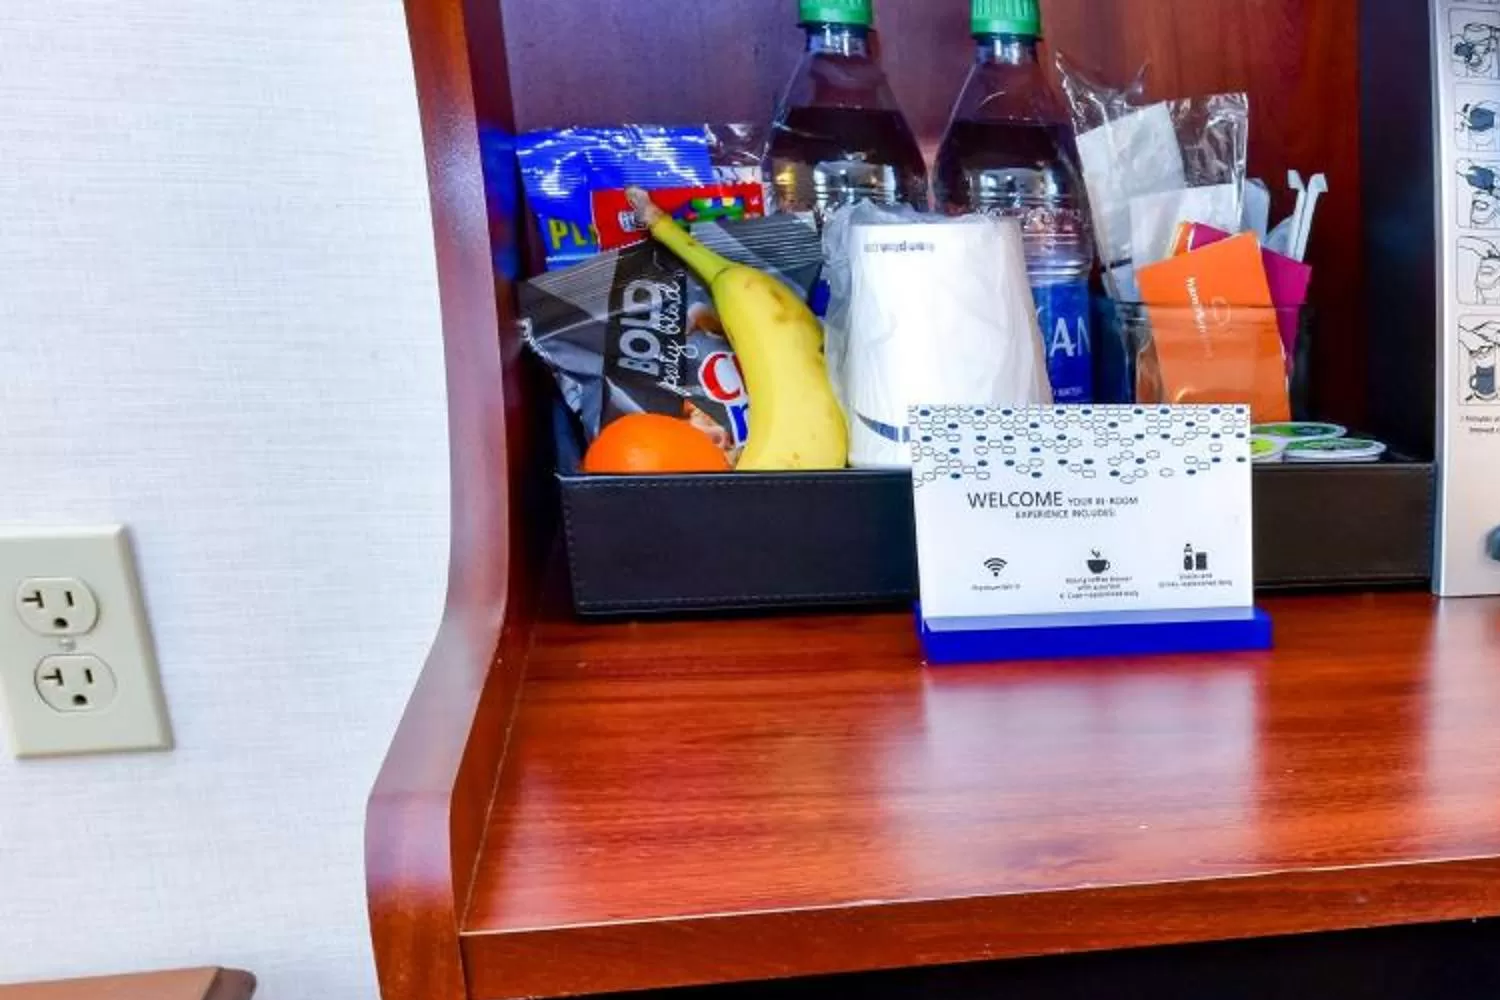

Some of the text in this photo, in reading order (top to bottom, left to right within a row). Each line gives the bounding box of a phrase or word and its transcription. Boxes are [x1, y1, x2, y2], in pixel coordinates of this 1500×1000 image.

[616, 279, 664, 377] BOLD
[967, 491, 1063, 509] WELCOME
[1068, 497, 1093, 506] YOUR
[1015, 509, 1069, 519] EXPERIENCE
